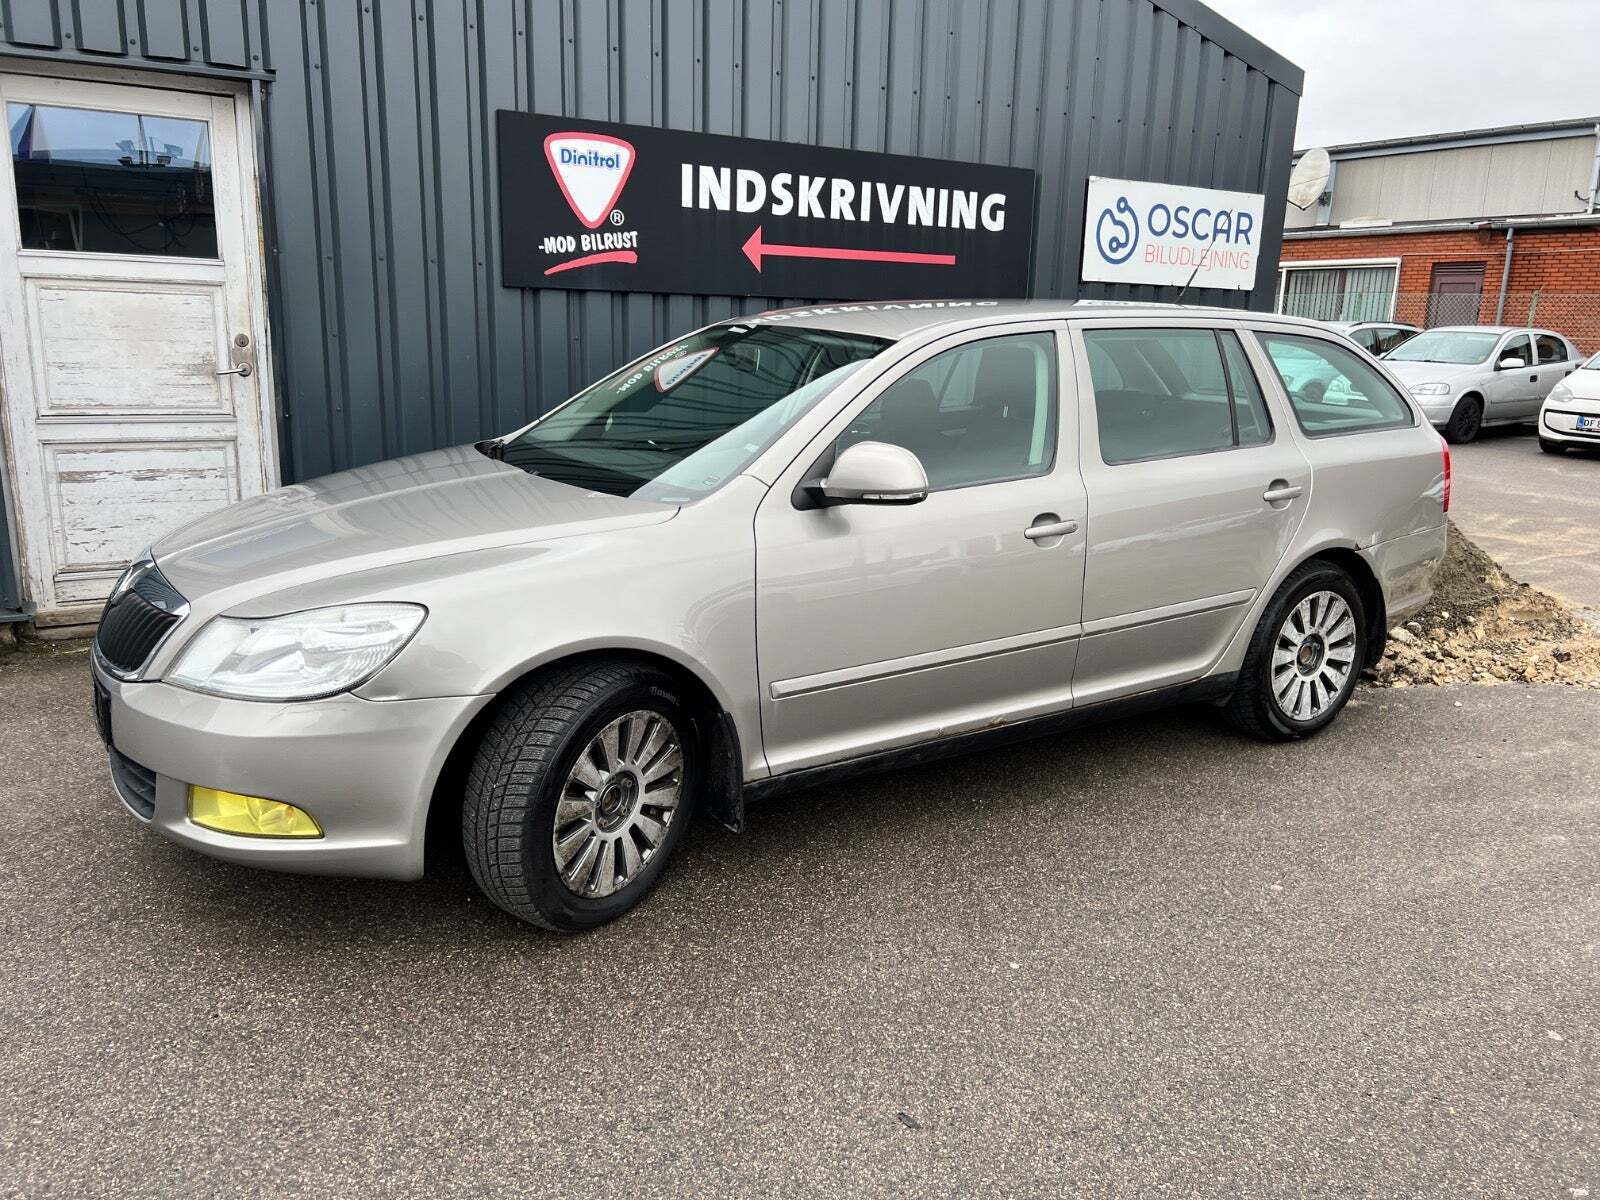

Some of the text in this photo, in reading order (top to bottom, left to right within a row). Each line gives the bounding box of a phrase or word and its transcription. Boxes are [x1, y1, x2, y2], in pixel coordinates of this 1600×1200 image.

[560, 148, 620, 168] Dinitrol
[681, 163, 1006, 232] INDSKRIVNING
[1147, 203, 1253, 245] OSCAR
[580, 230, 638, 251] BILRUST
[1144, 244, 1250, 272] BILUDLEJNING
